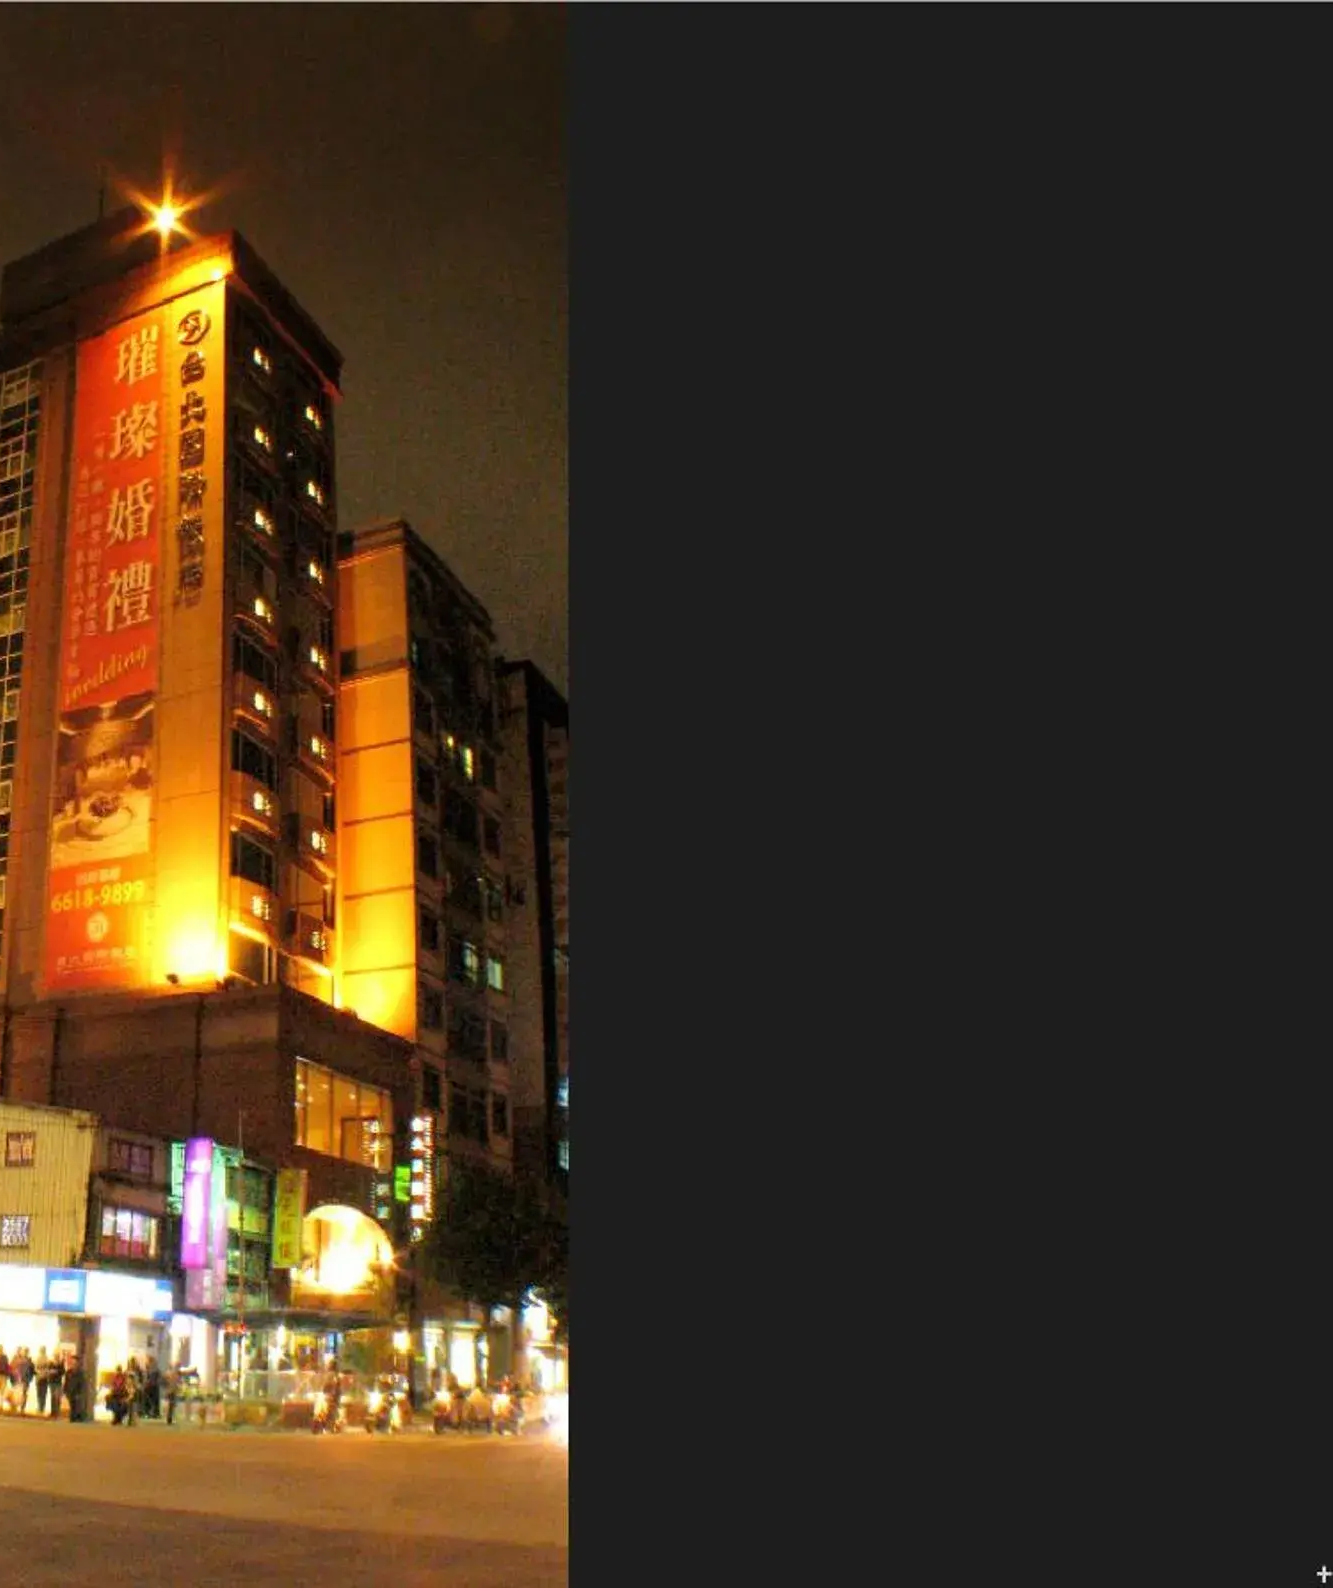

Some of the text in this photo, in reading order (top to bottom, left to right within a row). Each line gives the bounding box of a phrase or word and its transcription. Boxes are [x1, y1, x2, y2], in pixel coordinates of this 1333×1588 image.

[104, 324, 160, 632] 璀璨婚禮
[50, 879, 146, 914] 6618-9899
